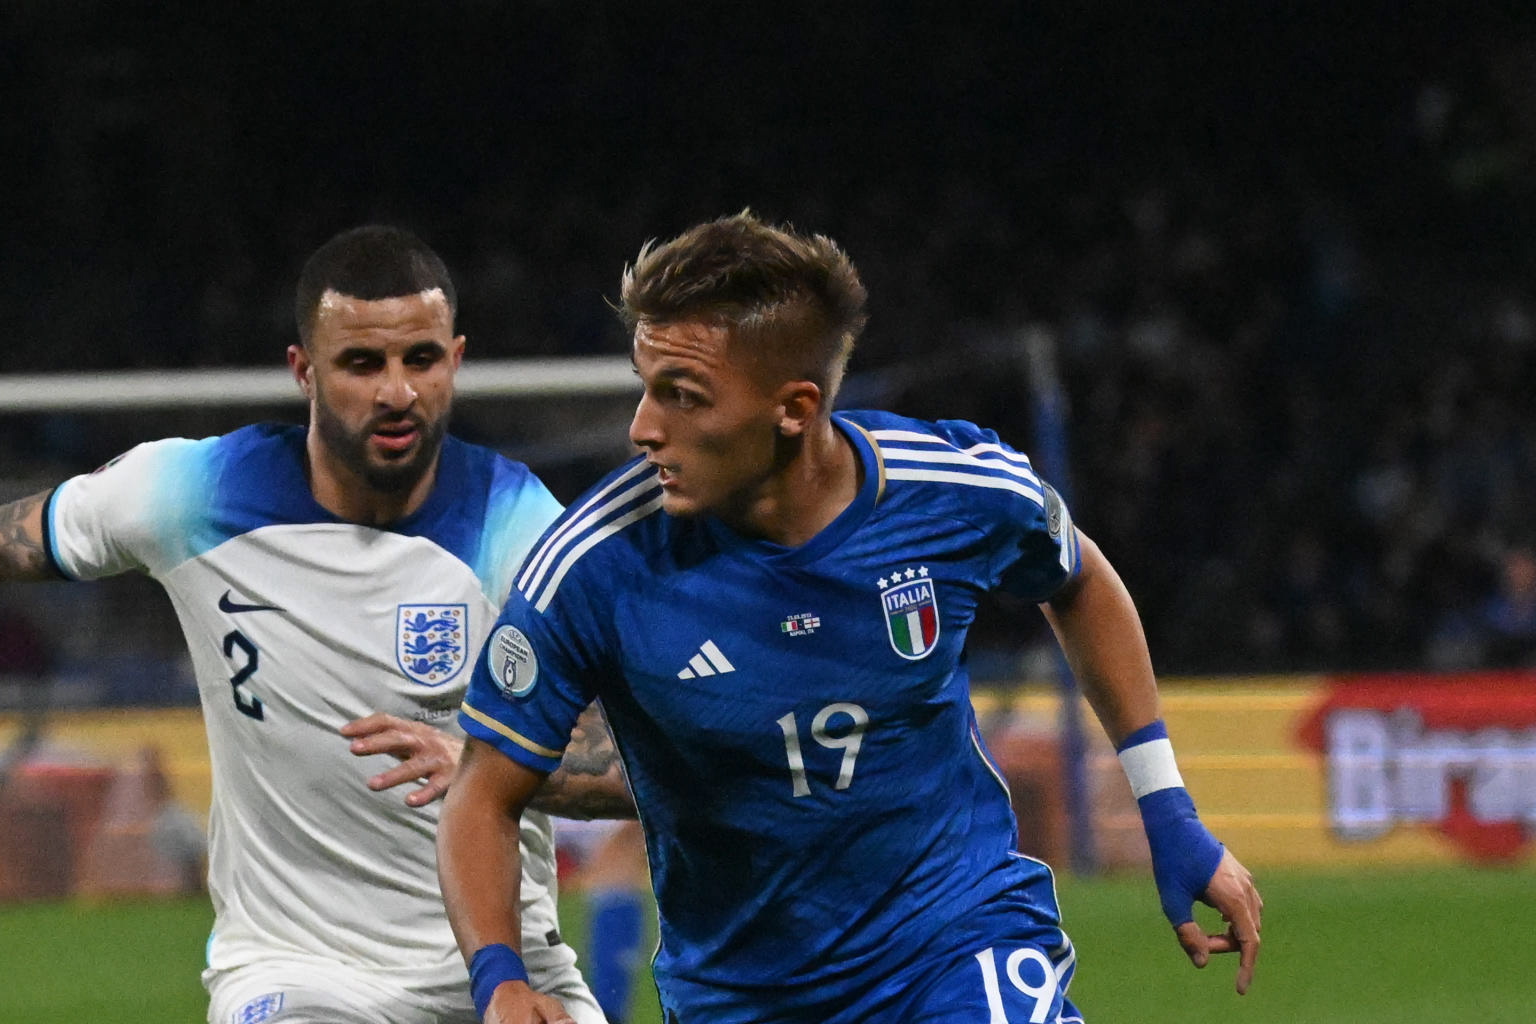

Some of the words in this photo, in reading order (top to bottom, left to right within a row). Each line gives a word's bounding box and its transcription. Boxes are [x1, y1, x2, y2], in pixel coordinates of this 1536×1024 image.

[886, 585, 931, 611] ITALIA
[222, 629, 265, 722] 2
[500, 635, 529, 657] EUROPEAN
[776, 702, 870, 798] 19
